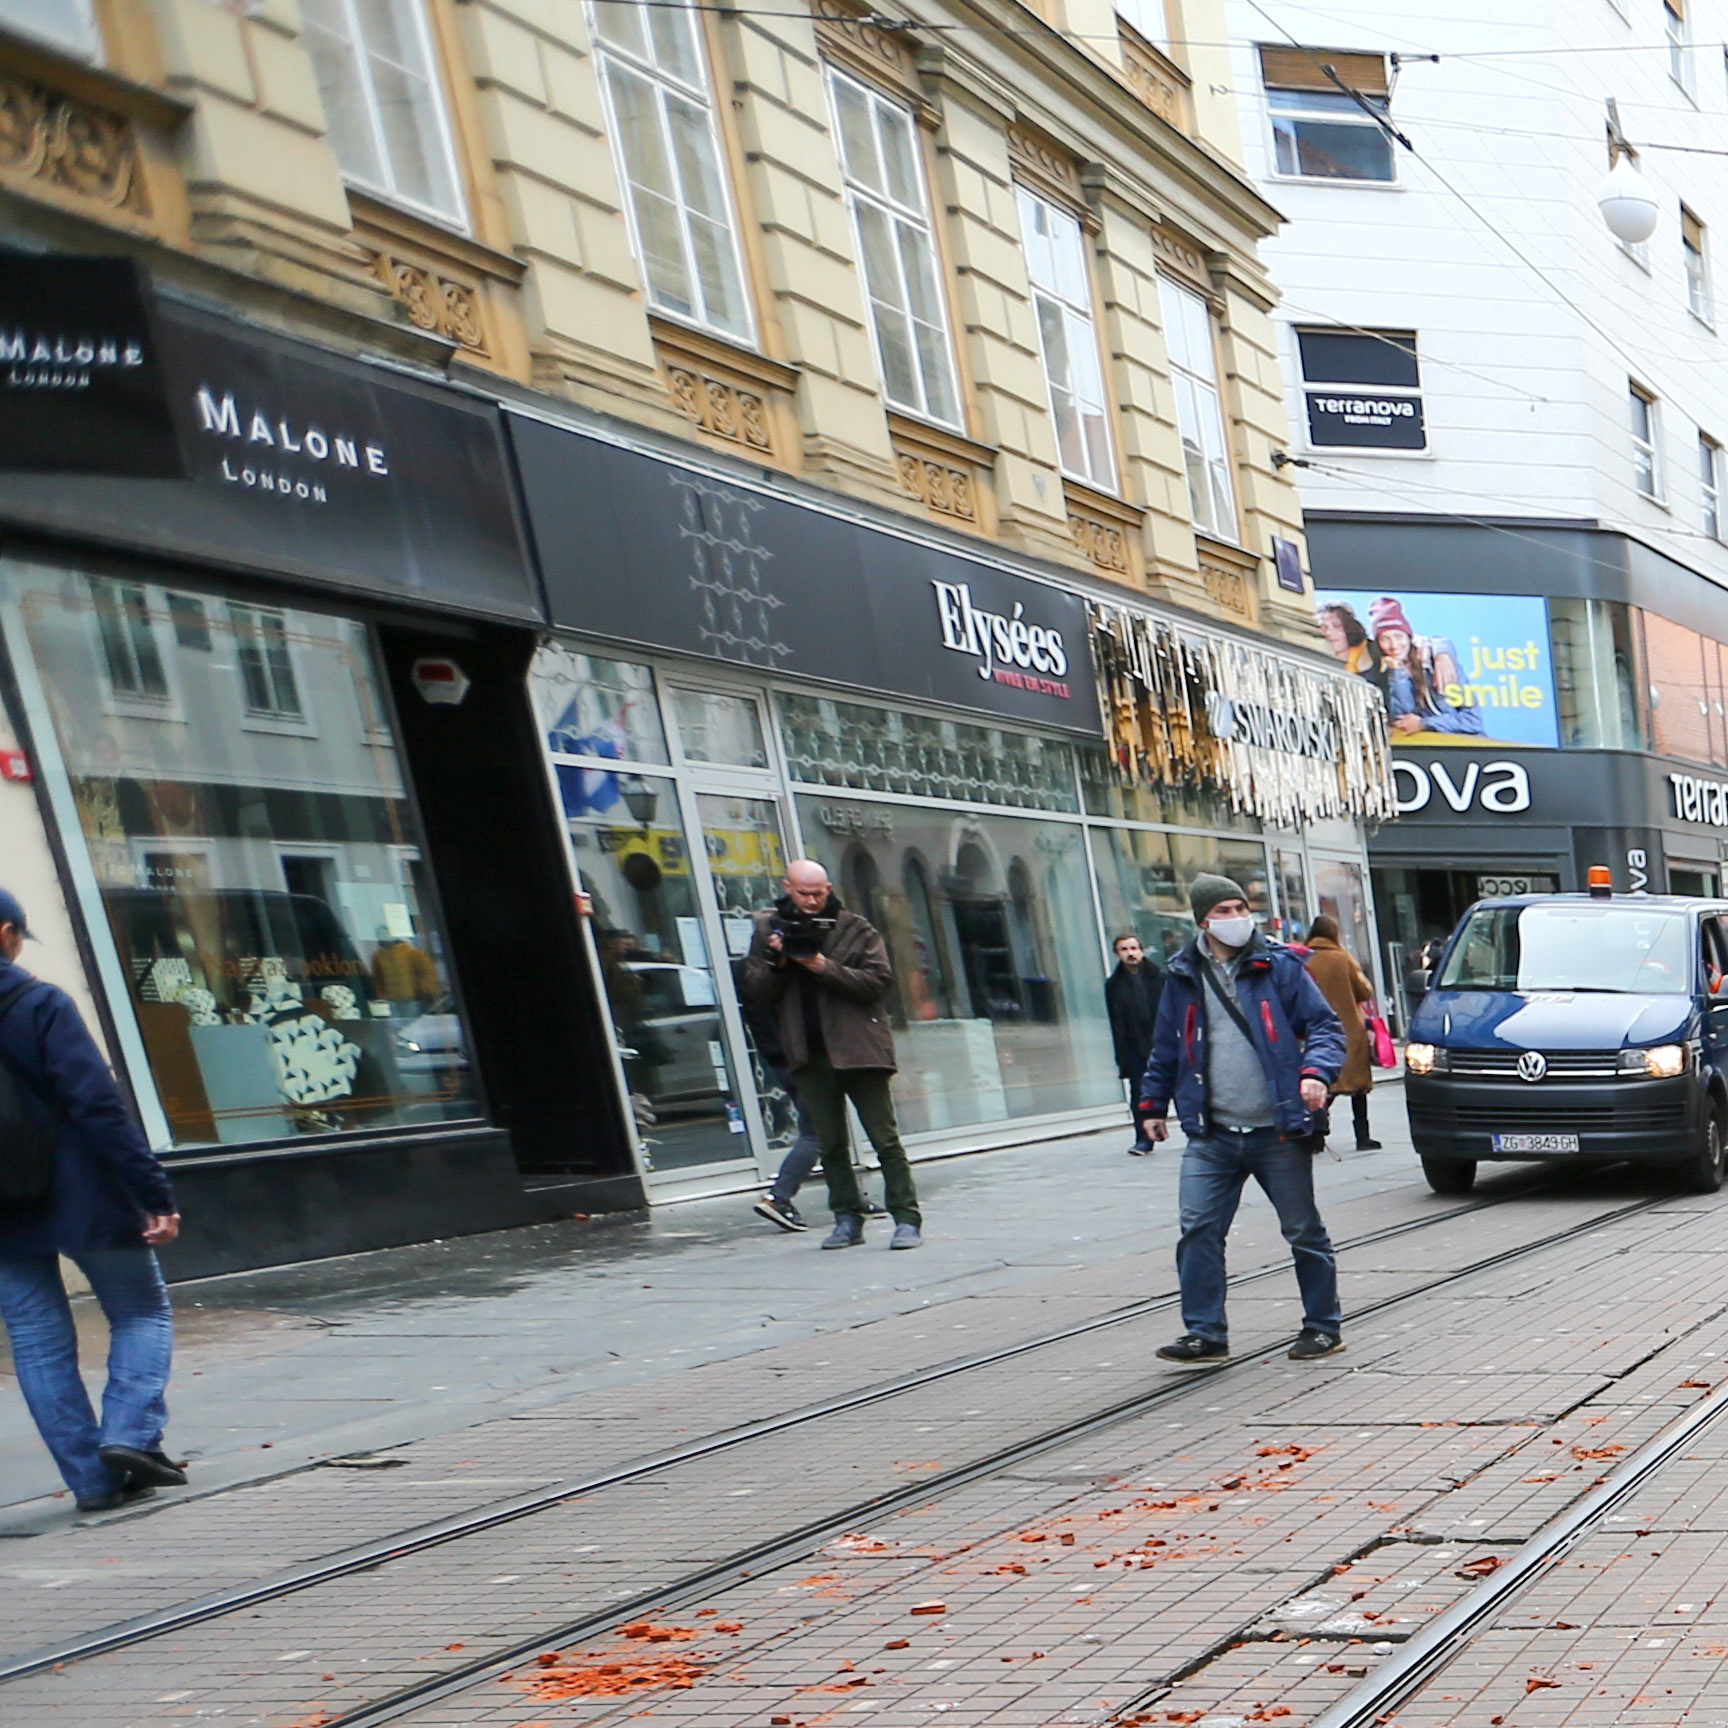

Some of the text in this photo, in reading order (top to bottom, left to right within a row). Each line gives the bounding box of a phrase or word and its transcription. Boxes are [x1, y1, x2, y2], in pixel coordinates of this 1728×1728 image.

[9, 368, 90, 388] LONDON
[199, 384, 389, 475] MALONE
[222, 454, 328, 502] LONDON
[930, 579, 1068, 681] Elysées
[1469, 637, 1540, 678] just
[1444, 674, 1543, 708] smile
[1231, 698, 1339, 763] SWAROVSKI
